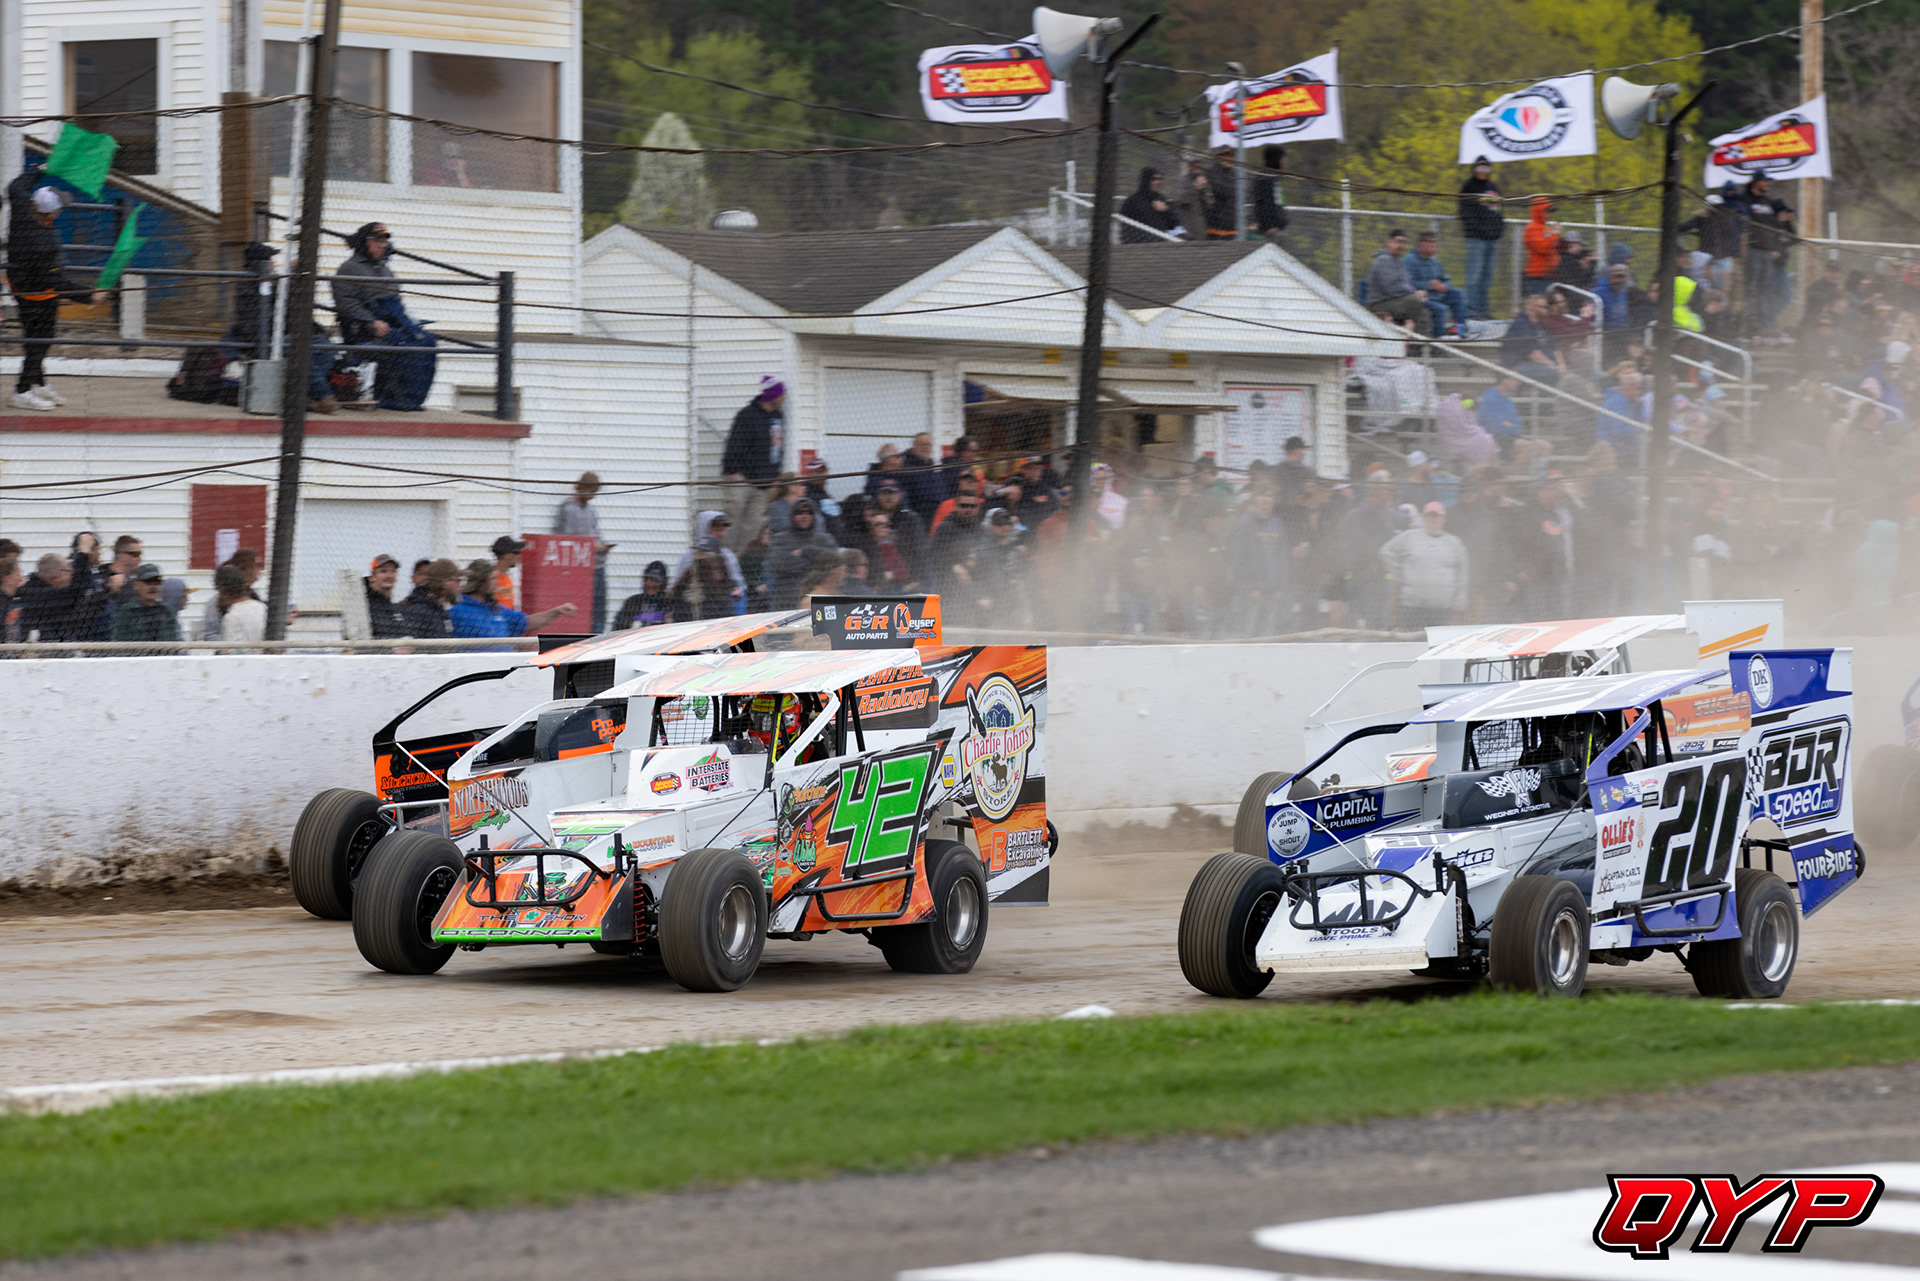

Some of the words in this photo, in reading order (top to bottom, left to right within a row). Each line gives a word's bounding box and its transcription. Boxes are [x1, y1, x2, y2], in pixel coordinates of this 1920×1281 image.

[541, 540, 592, 567] ATM
[866, 632, 889, 640] PARTS
[1752, 669, 1768, 686] DK
[859, 687, 929, 715] Radiology
[592, 719, 613, 731] Pro
[965, 733, 1001, 767] Charlie
[1002, 726, 1029, 760] Johns
[1763, 727, 1842, 791] BDR
[687, 760, 729, 777] INTERSTATE
[944, 764, 954, 779] NAPA
[386, 782, 440, 795] CONSTRUCTION
[691, 772, 729, 788] BATTERIES
[454, 777, 530, 818] NORTHWOODS
[793, 785, 827, 805] Hutchins
[830, 751, 932, 868] 42
[1323, 796, 1378, 820] CAPITAL
[1484, 808, 1520, 820] WEGNER
[1520, 802, 1551, 813] AUTOMOTIVE
[1279, 818, 1298, 828] JUMP
[1329, 814, 1376, 829] PLUMBING
[1641, 756, 1747, 899] 20
[632, 835, 675, 848] MOUNTAIN
[1007, 829, 1043, 847] BARTLETT
[1279, 835, 1301, 846] SHOUT
[1007, 844, 1043, 862] Excavating
[545, 913, 587, 921] SHOW
[440, 928, 598, 937] O'CONNOR
[1332, 927, 1380, 935] TOOLS
